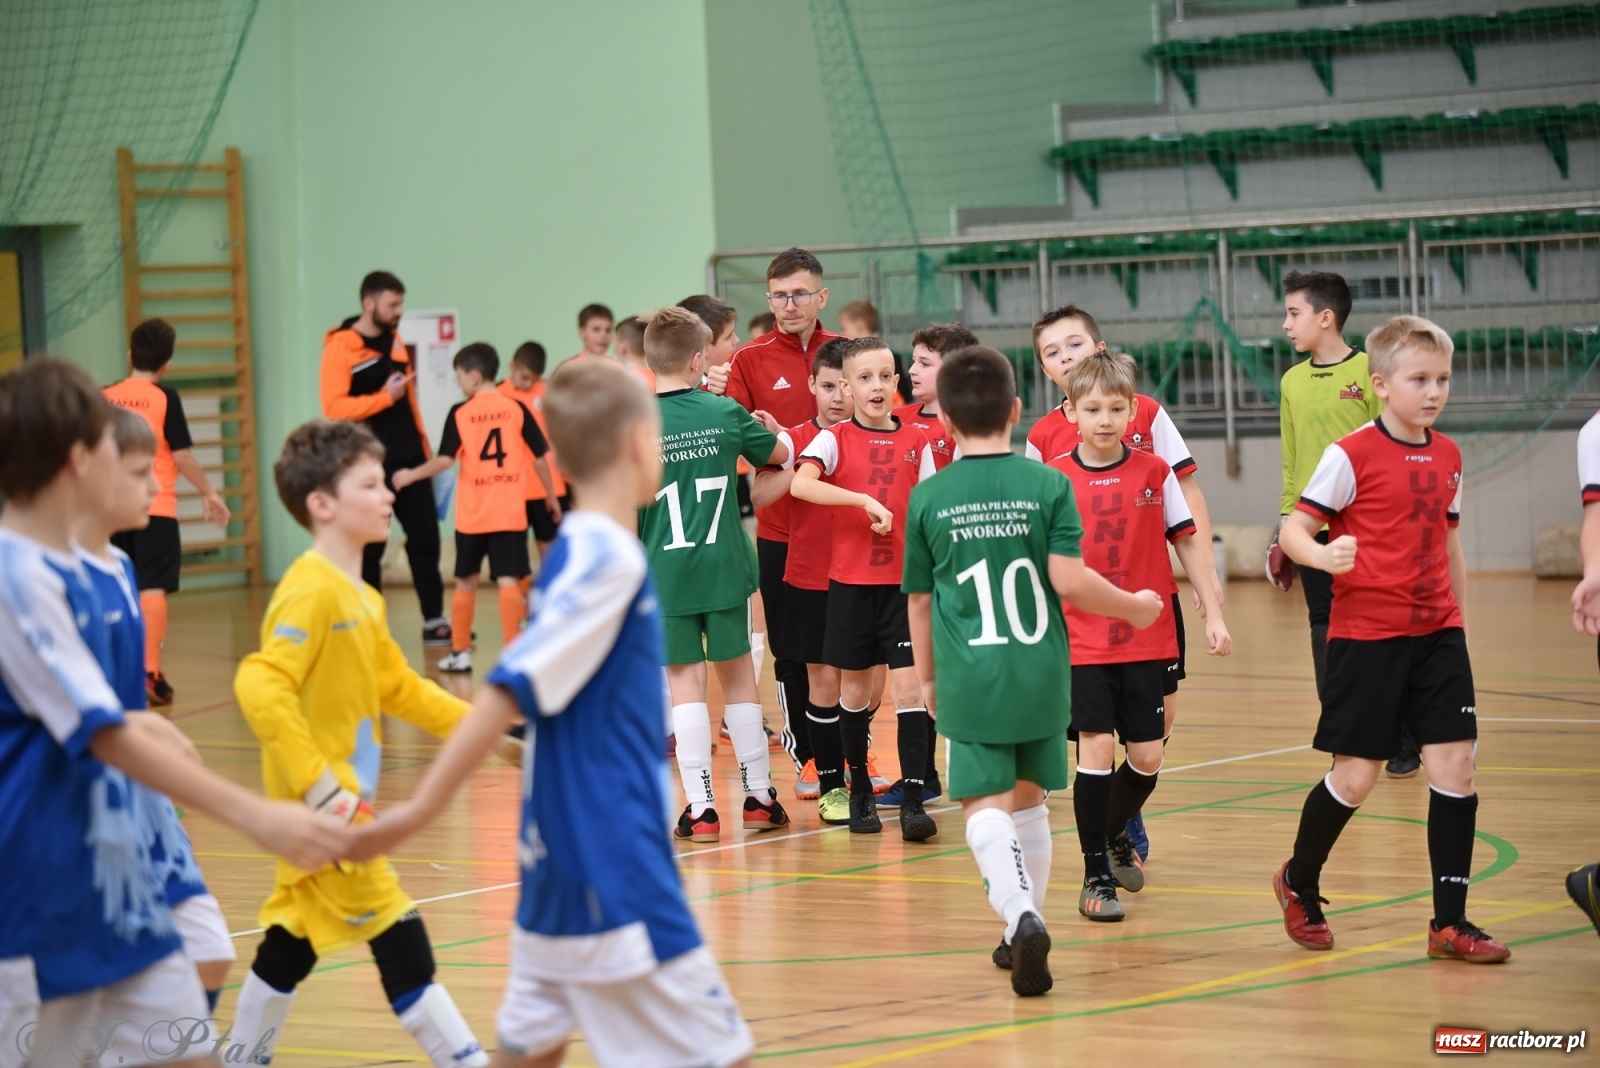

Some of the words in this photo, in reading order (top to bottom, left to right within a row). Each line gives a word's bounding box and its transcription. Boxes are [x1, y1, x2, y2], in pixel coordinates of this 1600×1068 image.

[479, 427, 508, 468] 4
[868, 438, 894, 446] regio
[1405, 455, 1433, 463] regio
[1089, 476, 1121, 487] regio
[654, 475, 728, 551] 17
[955, 557, 1049, 646] 10
